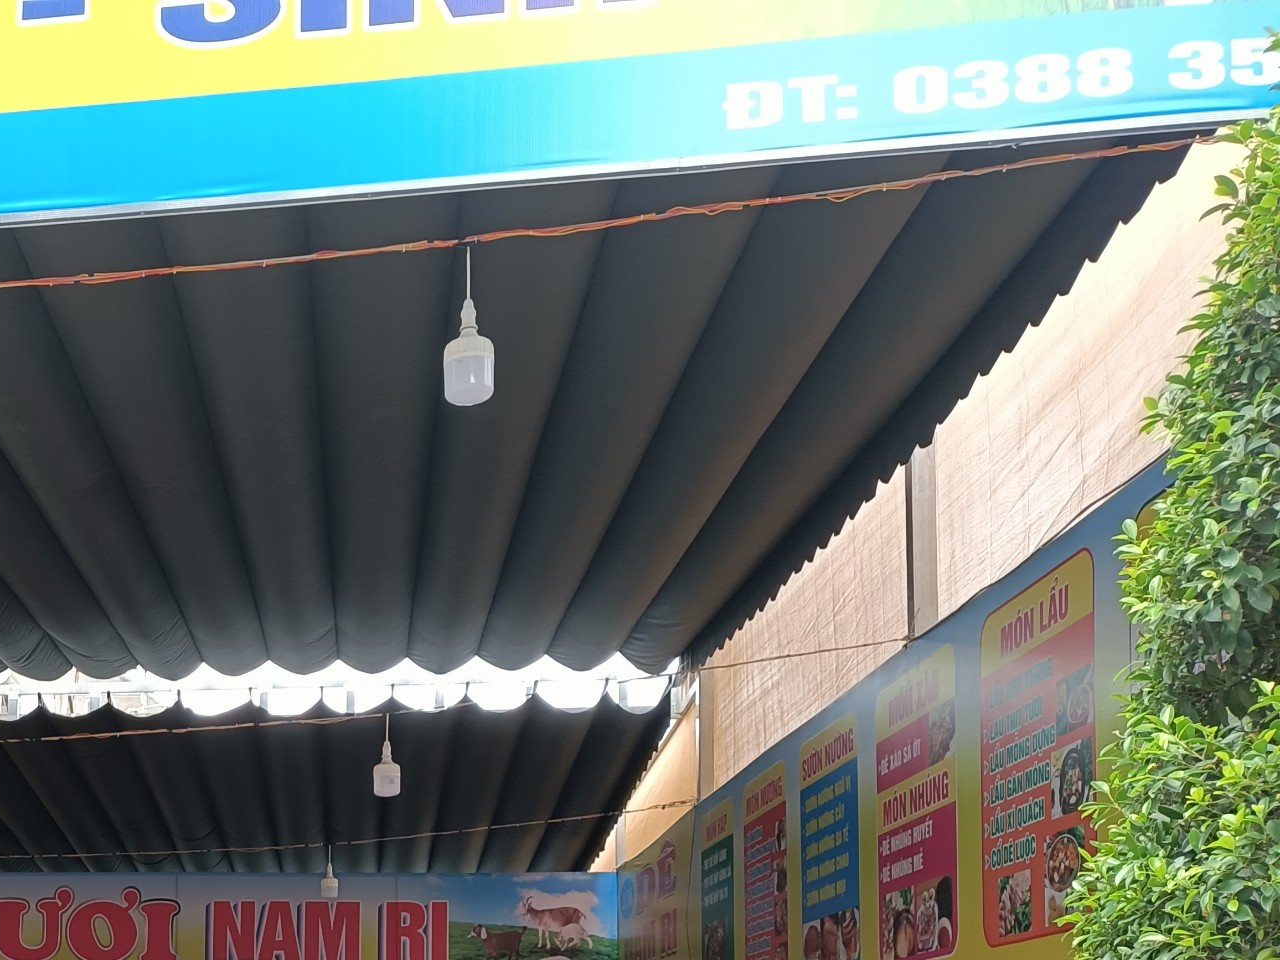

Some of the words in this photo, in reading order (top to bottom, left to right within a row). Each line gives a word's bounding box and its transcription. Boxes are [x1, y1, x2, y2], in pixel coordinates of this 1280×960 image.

[723, 73, 857, 130] ĐT:
[893, 48, 1133, 115] 0388
[1000, 607, 1035, 660] MÓN
[1039, 577, 1069, 634] LẨU
[802, 747, 823, 781] SƯỜN
[824, 728, 854, 768] NƯỚNG
[882, 790, 907, 828] MÓN
[909, 770, 949, 816] NHÚNG
[636, 840, 677, 915] DÊ
